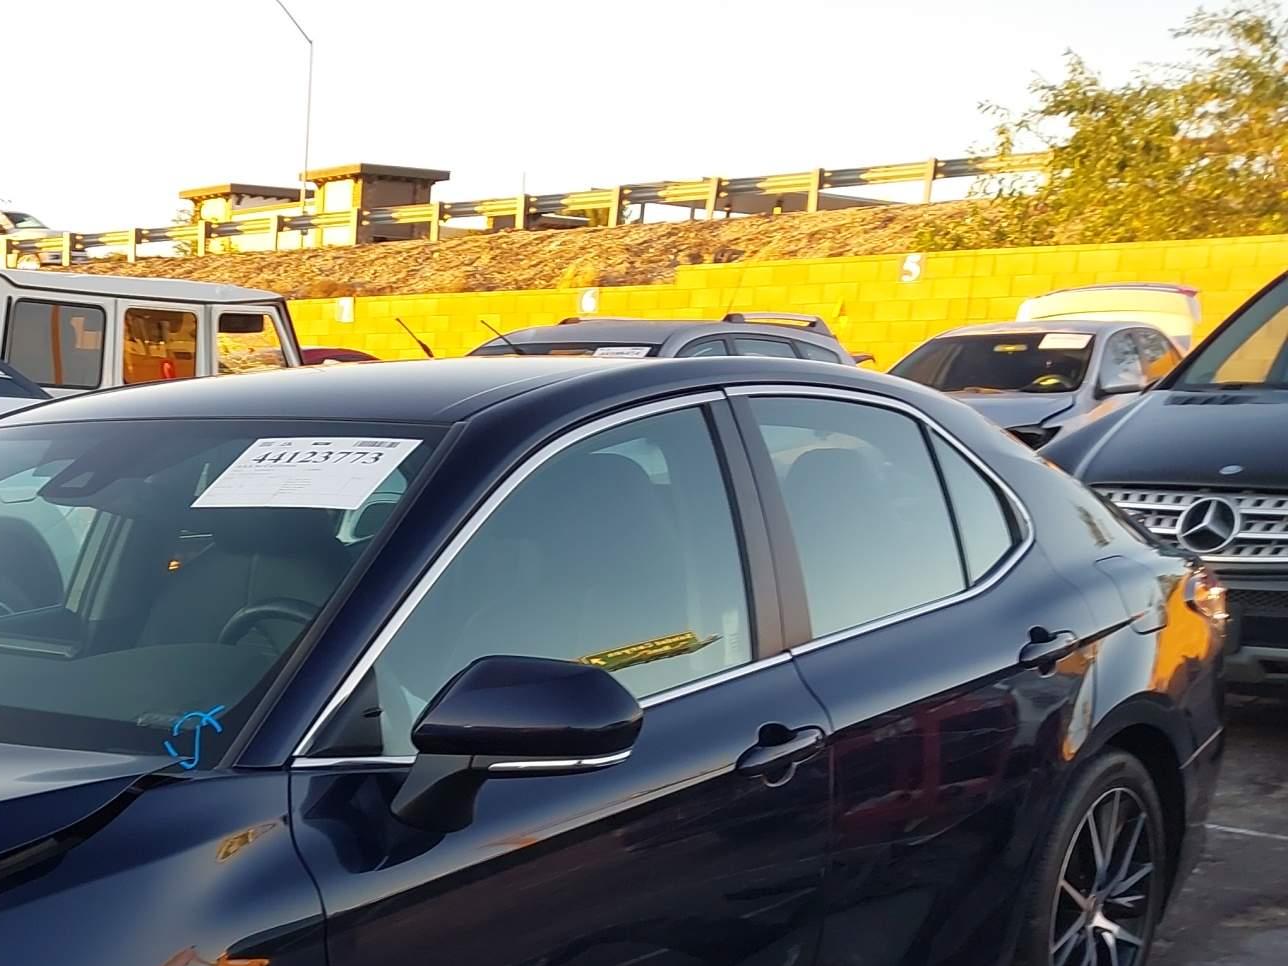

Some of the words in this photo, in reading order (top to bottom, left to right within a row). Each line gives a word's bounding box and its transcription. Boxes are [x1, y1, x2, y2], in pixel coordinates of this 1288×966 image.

[902, 253, 921, 282] 5
[580, 288, 597, 312] 6
[252, 451, 384, 464] 44123773
